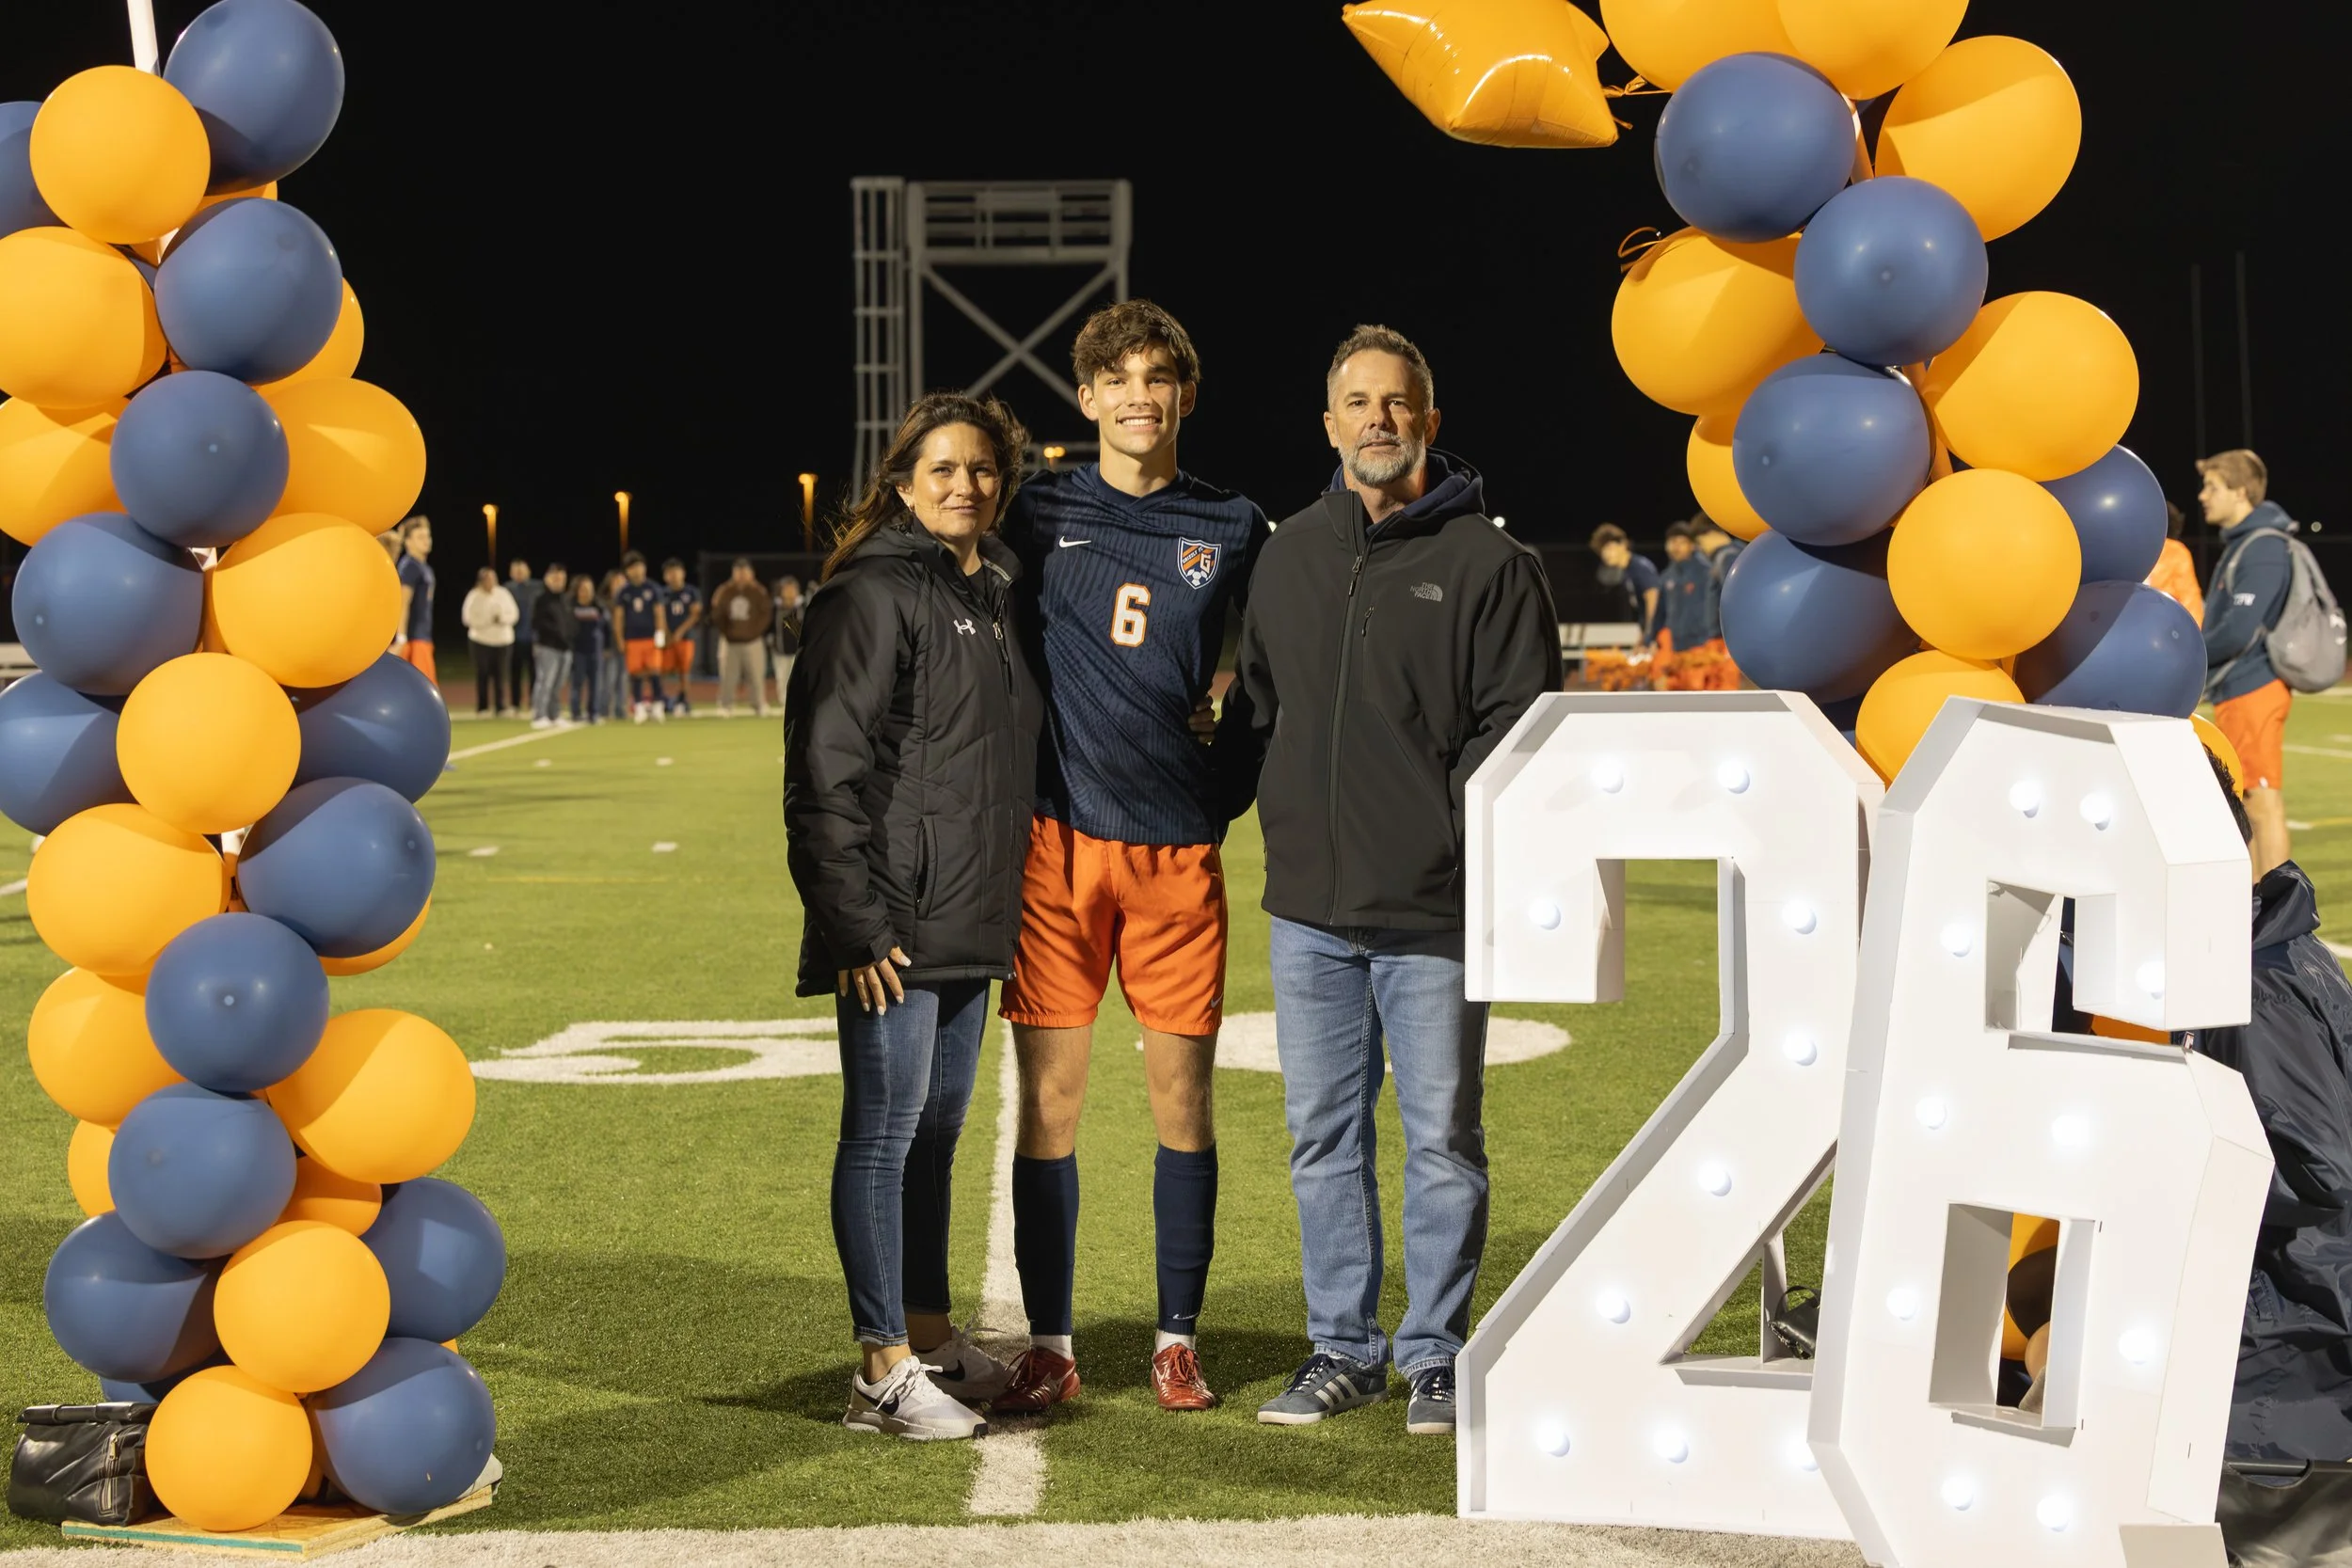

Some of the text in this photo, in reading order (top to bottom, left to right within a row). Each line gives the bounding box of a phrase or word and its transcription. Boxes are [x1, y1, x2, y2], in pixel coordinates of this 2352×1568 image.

[1200, 553, 1211, 574] G
[1110, 582, 1151, 647] 6
[1456, 691, 2274, 1568] 26
